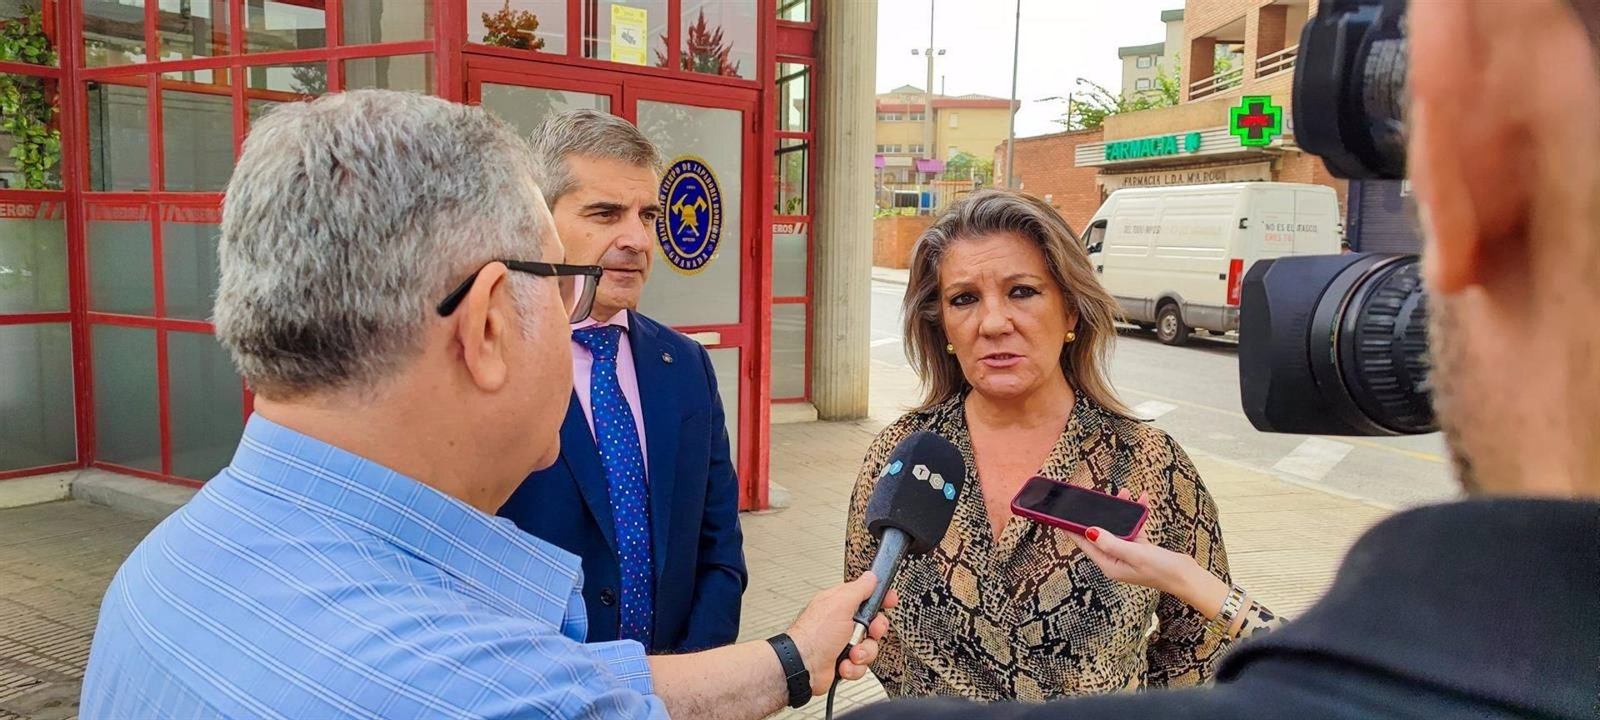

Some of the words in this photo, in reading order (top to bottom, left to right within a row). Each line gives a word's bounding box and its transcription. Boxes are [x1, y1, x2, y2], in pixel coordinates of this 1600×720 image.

[1105, 135, 1178, 161] FARMACIA
[1123, 174, 1160, 187] FARMACIA
[0, 202, 35, 218] EROS
[772, 224, 793, 233] EROS
[668, 252, 708, 269] GRANADA
